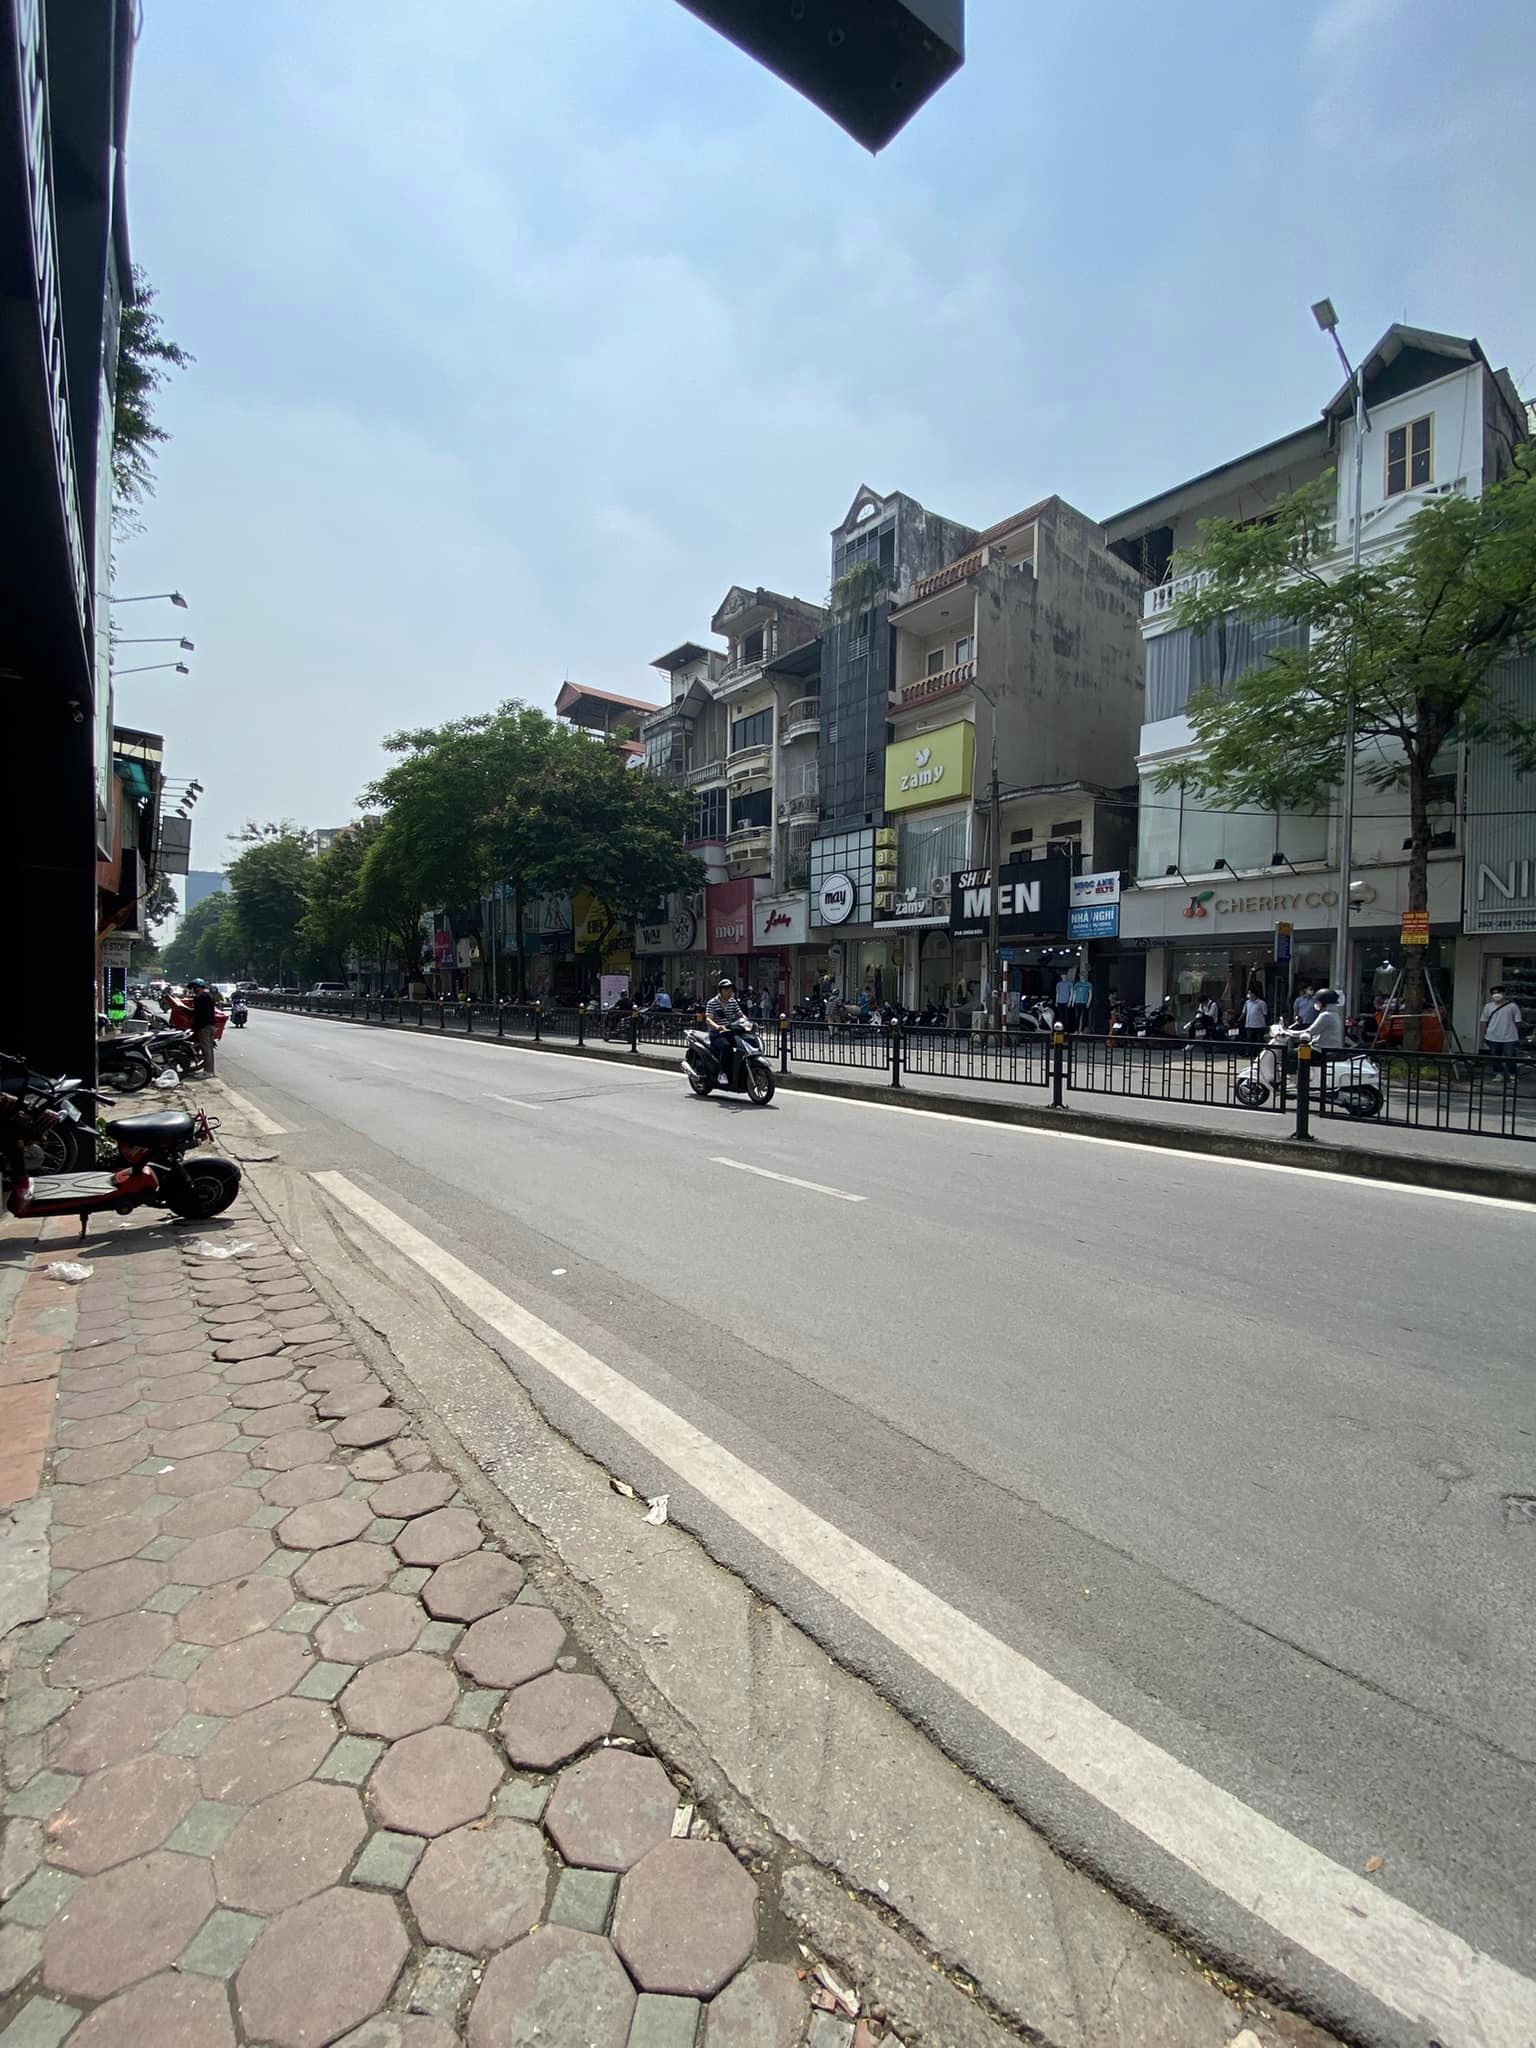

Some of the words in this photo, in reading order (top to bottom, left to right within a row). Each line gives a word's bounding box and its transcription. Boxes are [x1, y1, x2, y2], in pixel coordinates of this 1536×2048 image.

[900, 763, 944, 792] zamy
[1478, 859, 1536, 901] NI
[824, 889, 847, 906] may
[895, 900, 925, 915] zamy
[963, 880, 1041, 920] MEN
[1214, 892, 1303, 914] CHERRY
[714, 919, 744, 943] moji
